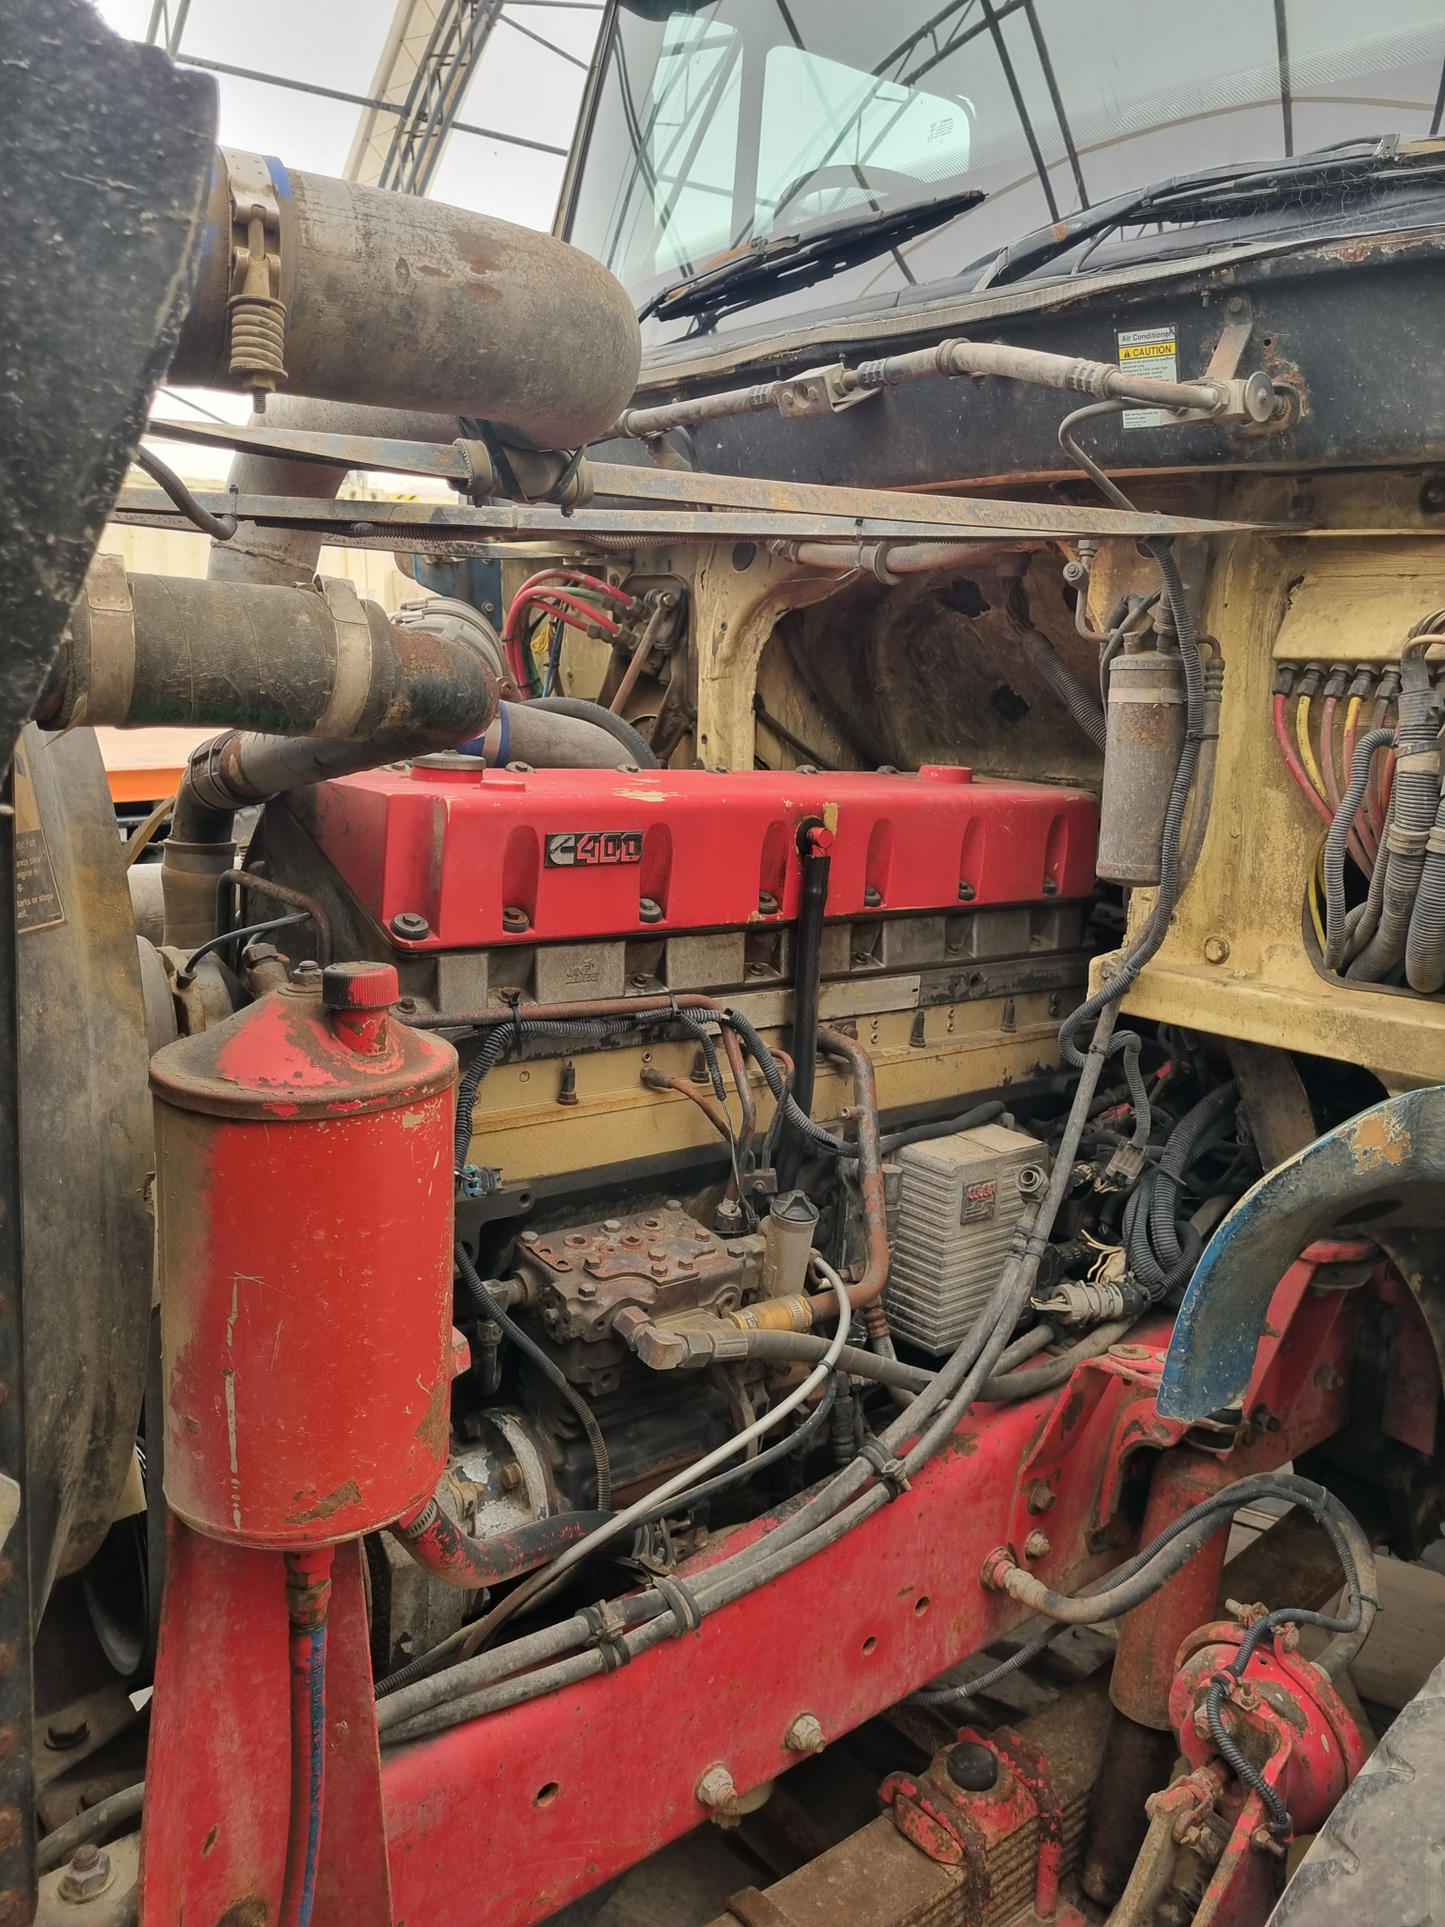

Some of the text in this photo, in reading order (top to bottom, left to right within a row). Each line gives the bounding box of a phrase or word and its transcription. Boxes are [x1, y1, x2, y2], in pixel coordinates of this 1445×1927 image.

[1122, 332, 1171, 342] Air Conditioner
[1133, 345, 1172, 357] CAUTION
[576, 832, 642, 864] 400
[16, 858, 29, 868] ands
[16, 868, 33, 880] ngine
[17, 892, 54, 908] tarts or stops
